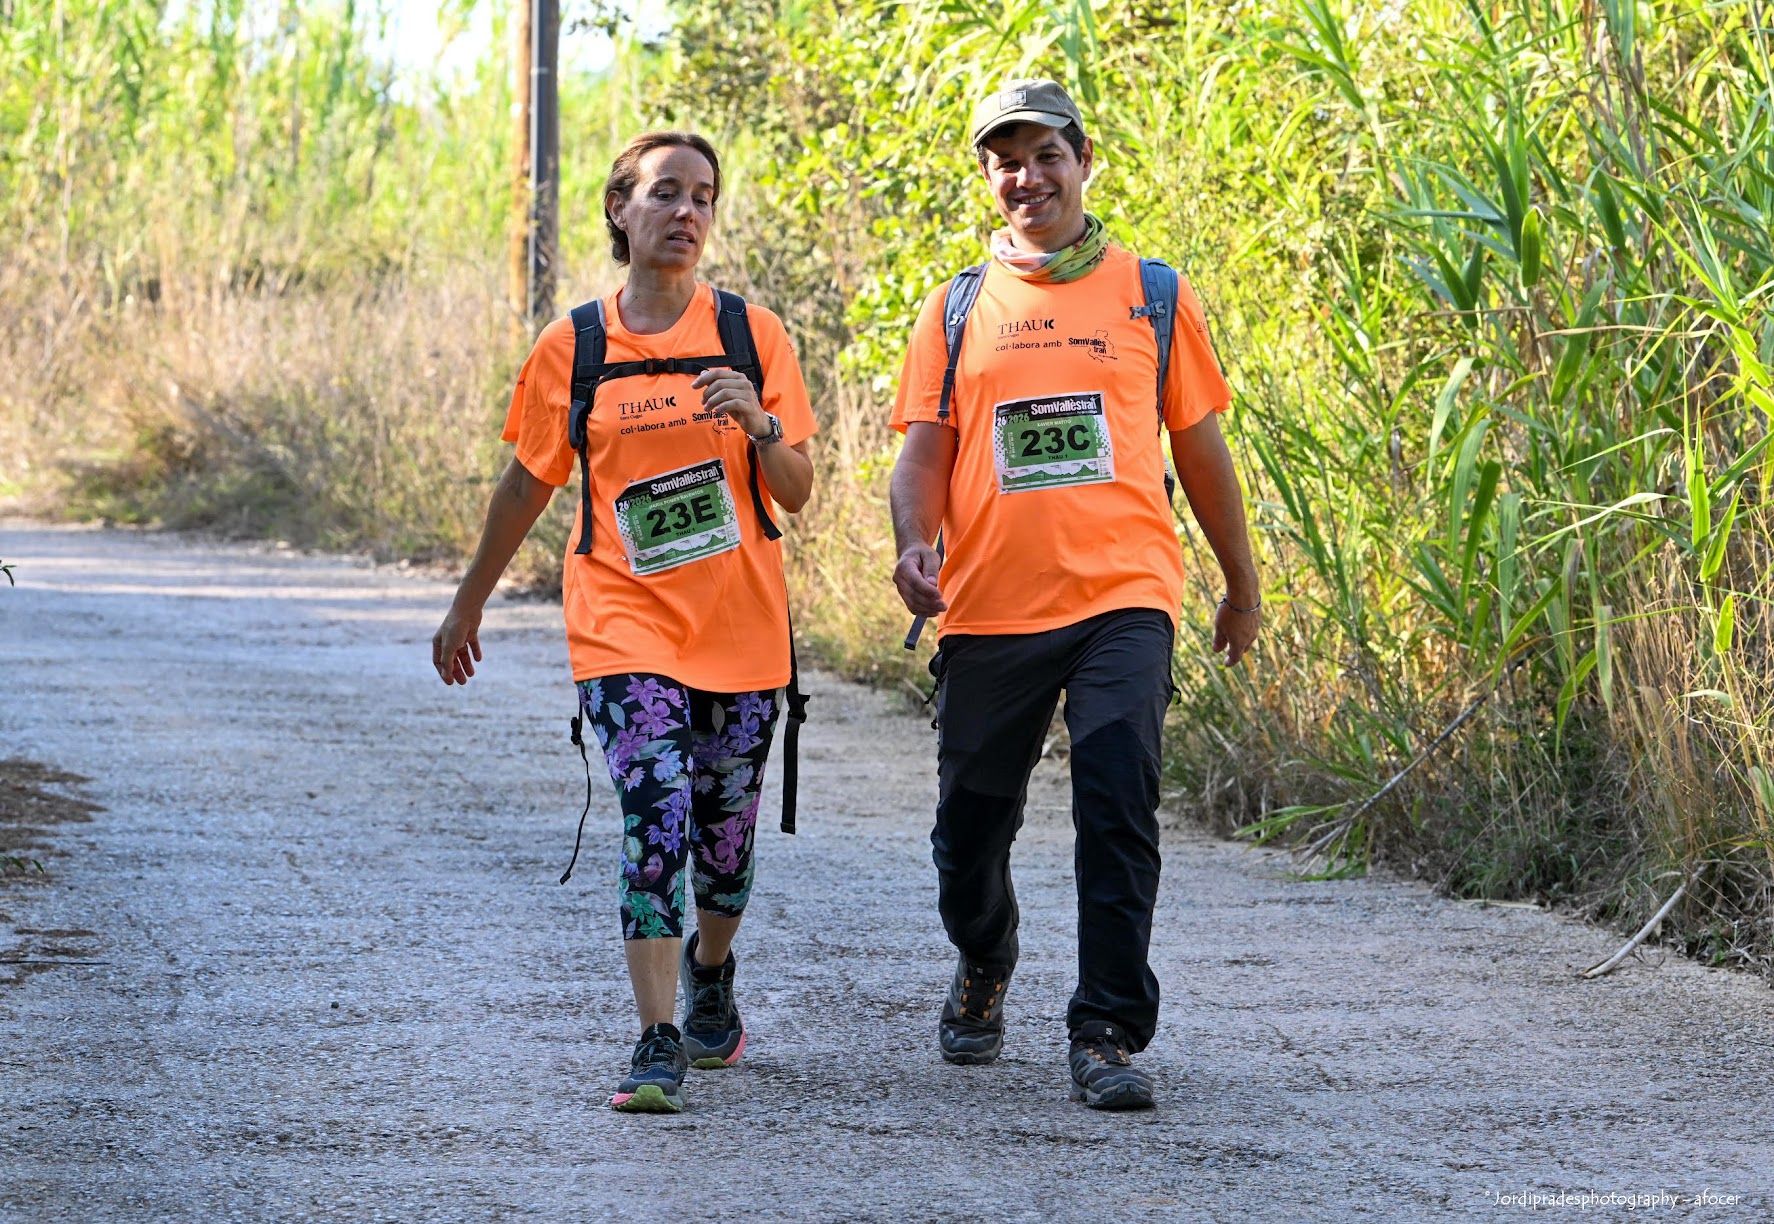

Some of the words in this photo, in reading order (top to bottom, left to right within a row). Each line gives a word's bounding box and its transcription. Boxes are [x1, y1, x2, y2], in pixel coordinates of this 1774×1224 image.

[997, 319, 1043, 335] THAU
[1043, 339, 1063, 348] amb
[1068, 336, 1107, 348] SomVallès
[1093, 346, 1107, 355] trail
[618, 397, 665, 416] THAU
[668, 417, 688, 428] amb
[1020, 424, 1091, 458] 23C
[646, 494, 718, 539] 23E
[675, 528, 691, 537] THAU
